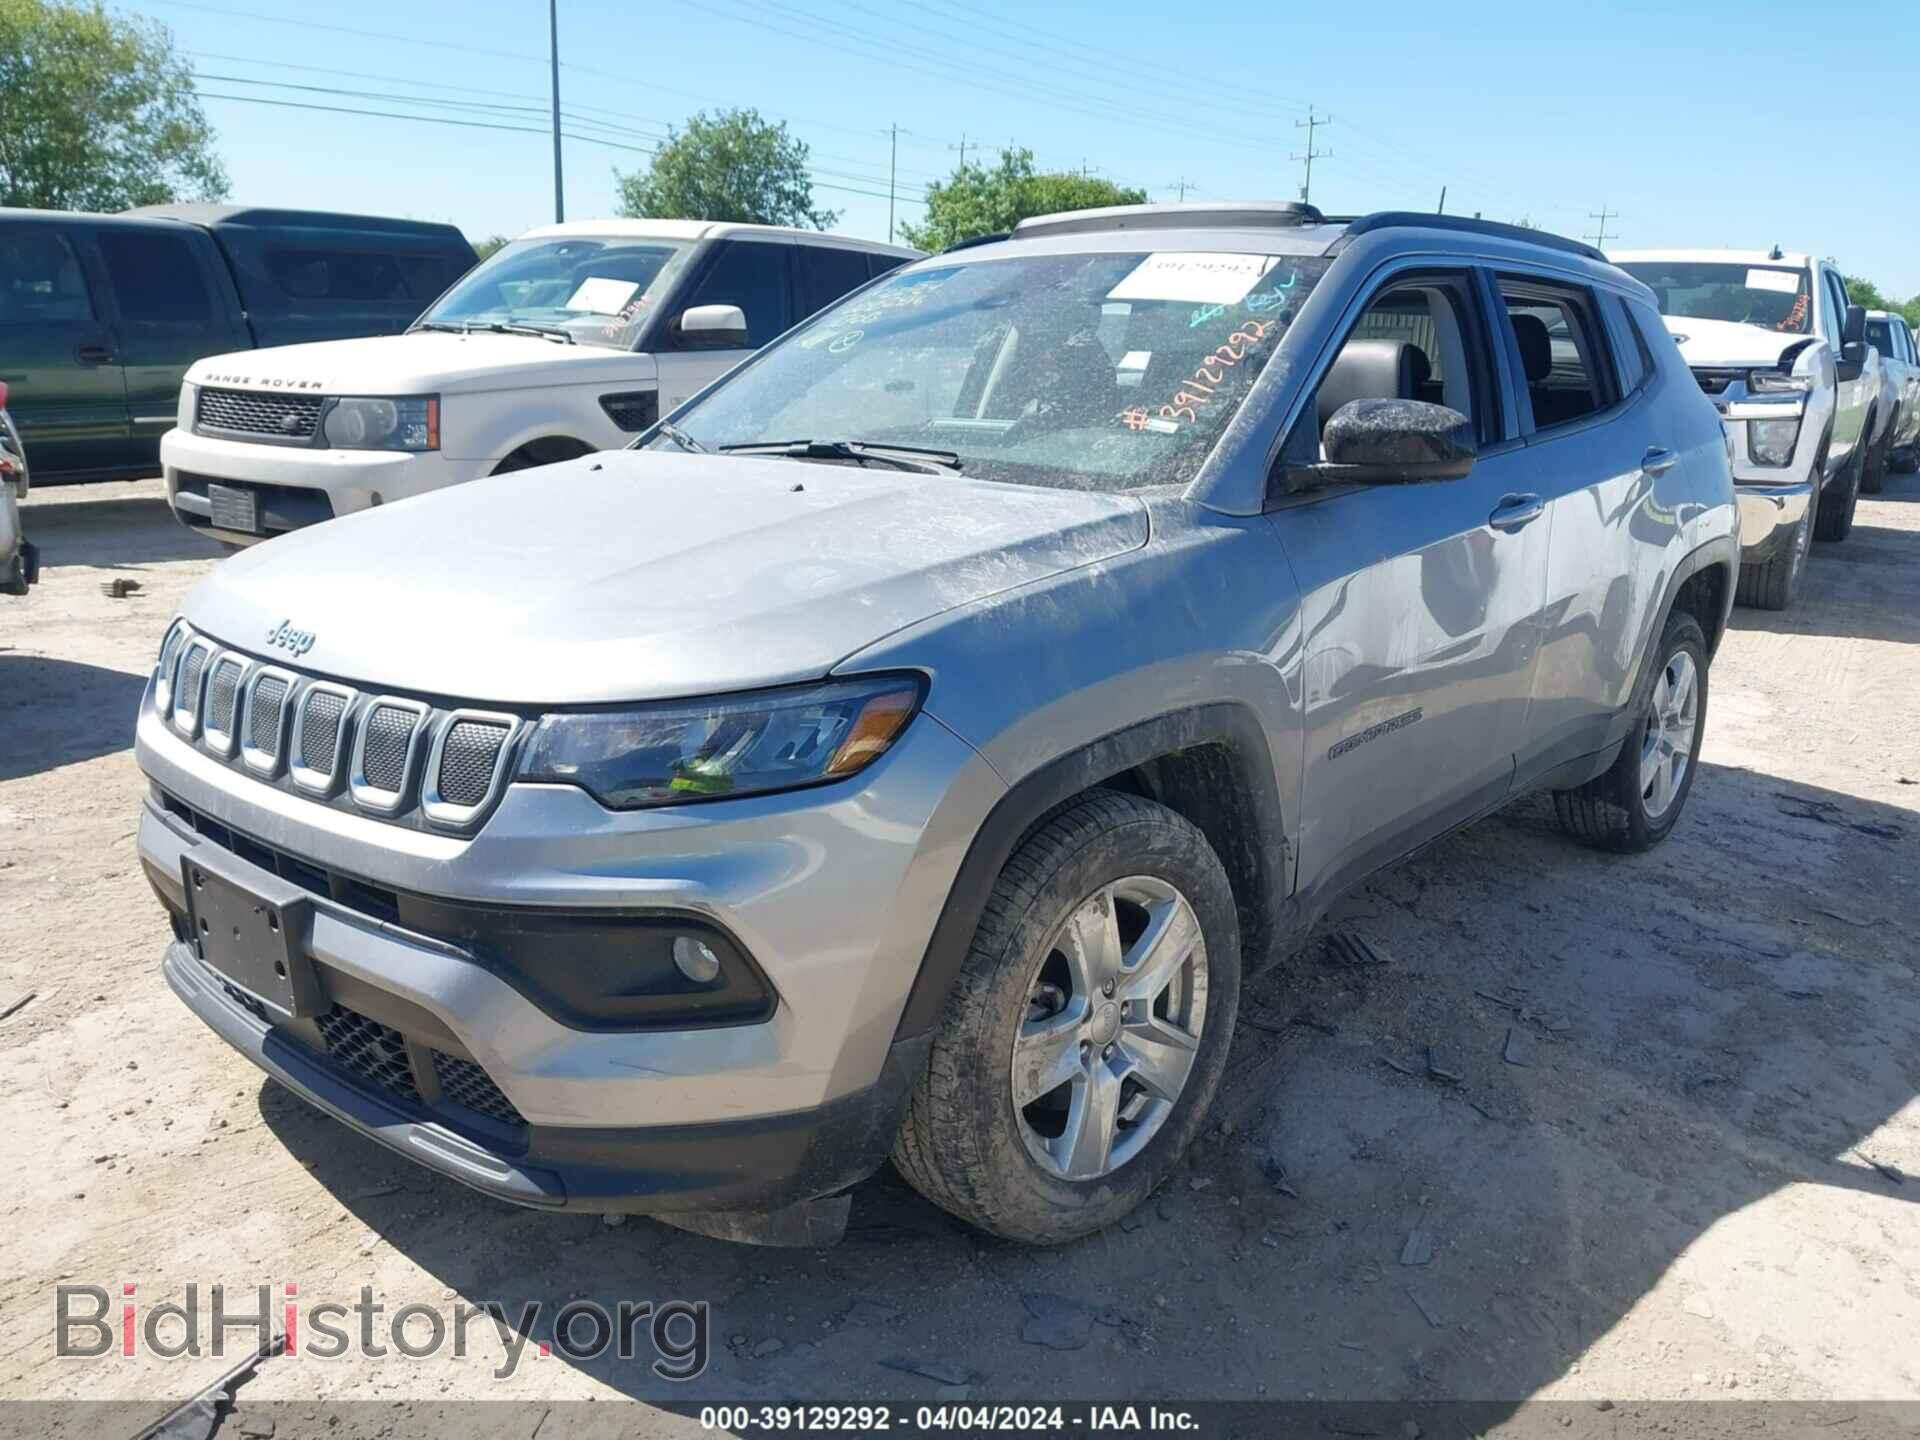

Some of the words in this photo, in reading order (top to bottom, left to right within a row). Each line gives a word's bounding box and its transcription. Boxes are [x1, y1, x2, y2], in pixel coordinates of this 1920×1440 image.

[205, 373, 252, 385] RANGE
[260, 377, 324, 389] ROVER
[1159, 320, 1275, 425] 39129292
[265, 618, 317, 659] Jeep
